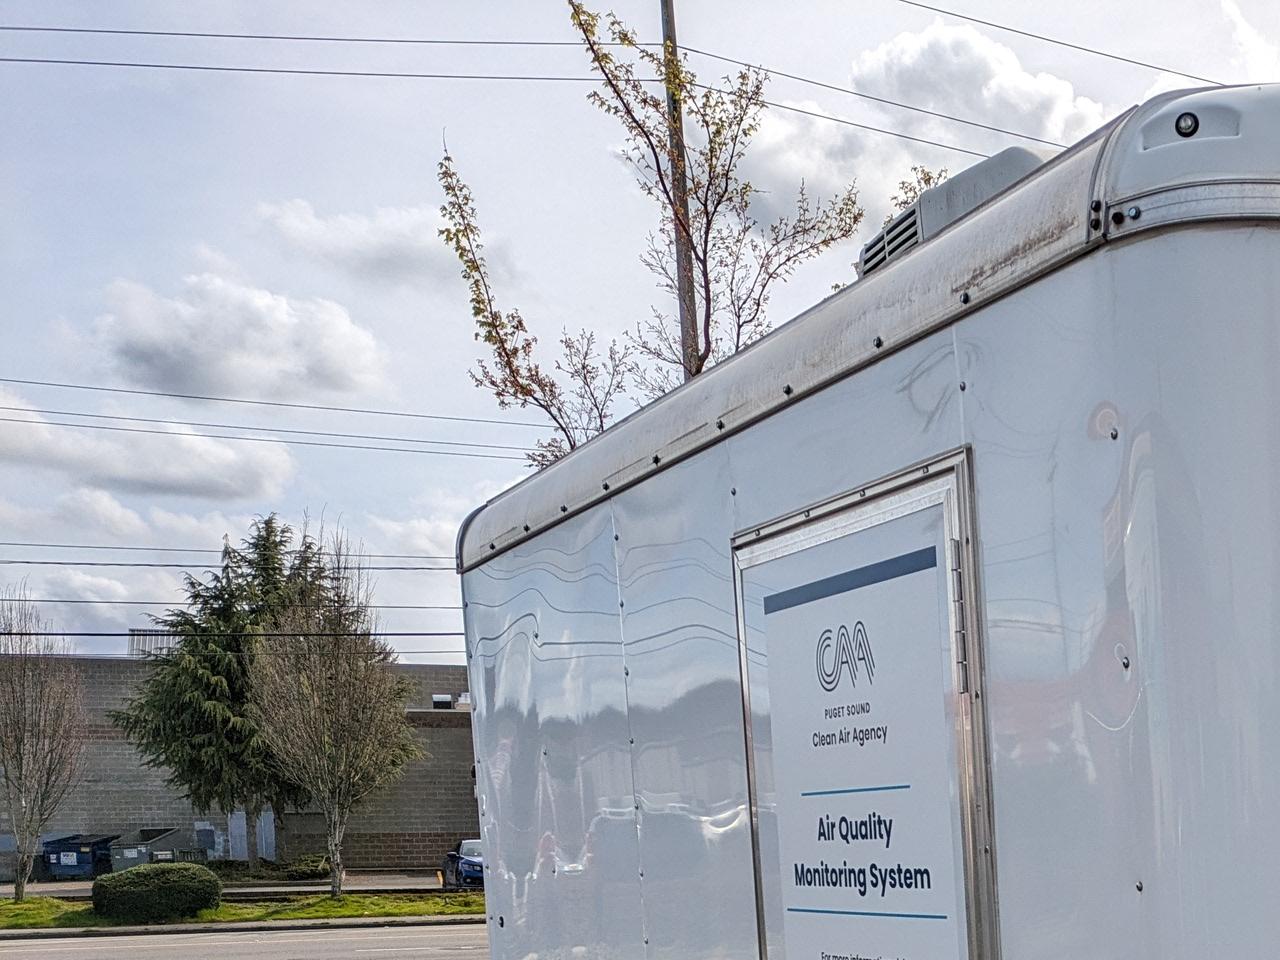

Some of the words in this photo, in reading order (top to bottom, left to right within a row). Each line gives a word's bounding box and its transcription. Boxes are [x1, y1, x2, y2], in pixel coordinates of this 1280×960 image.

[824, 705, 846, 720] PUGET
[846, 701, 871, 717] SOUND
[812, 731, 837, 747] Clean
[838, 726, 851, 745] Air
[852, 725, 888, 747] Agency
[817, 813, 836, 842] Air
[838, 811, 893, 849] Quality
[794, 860, 867, 897] Monitoring
[870, 862, 932, 898] System
